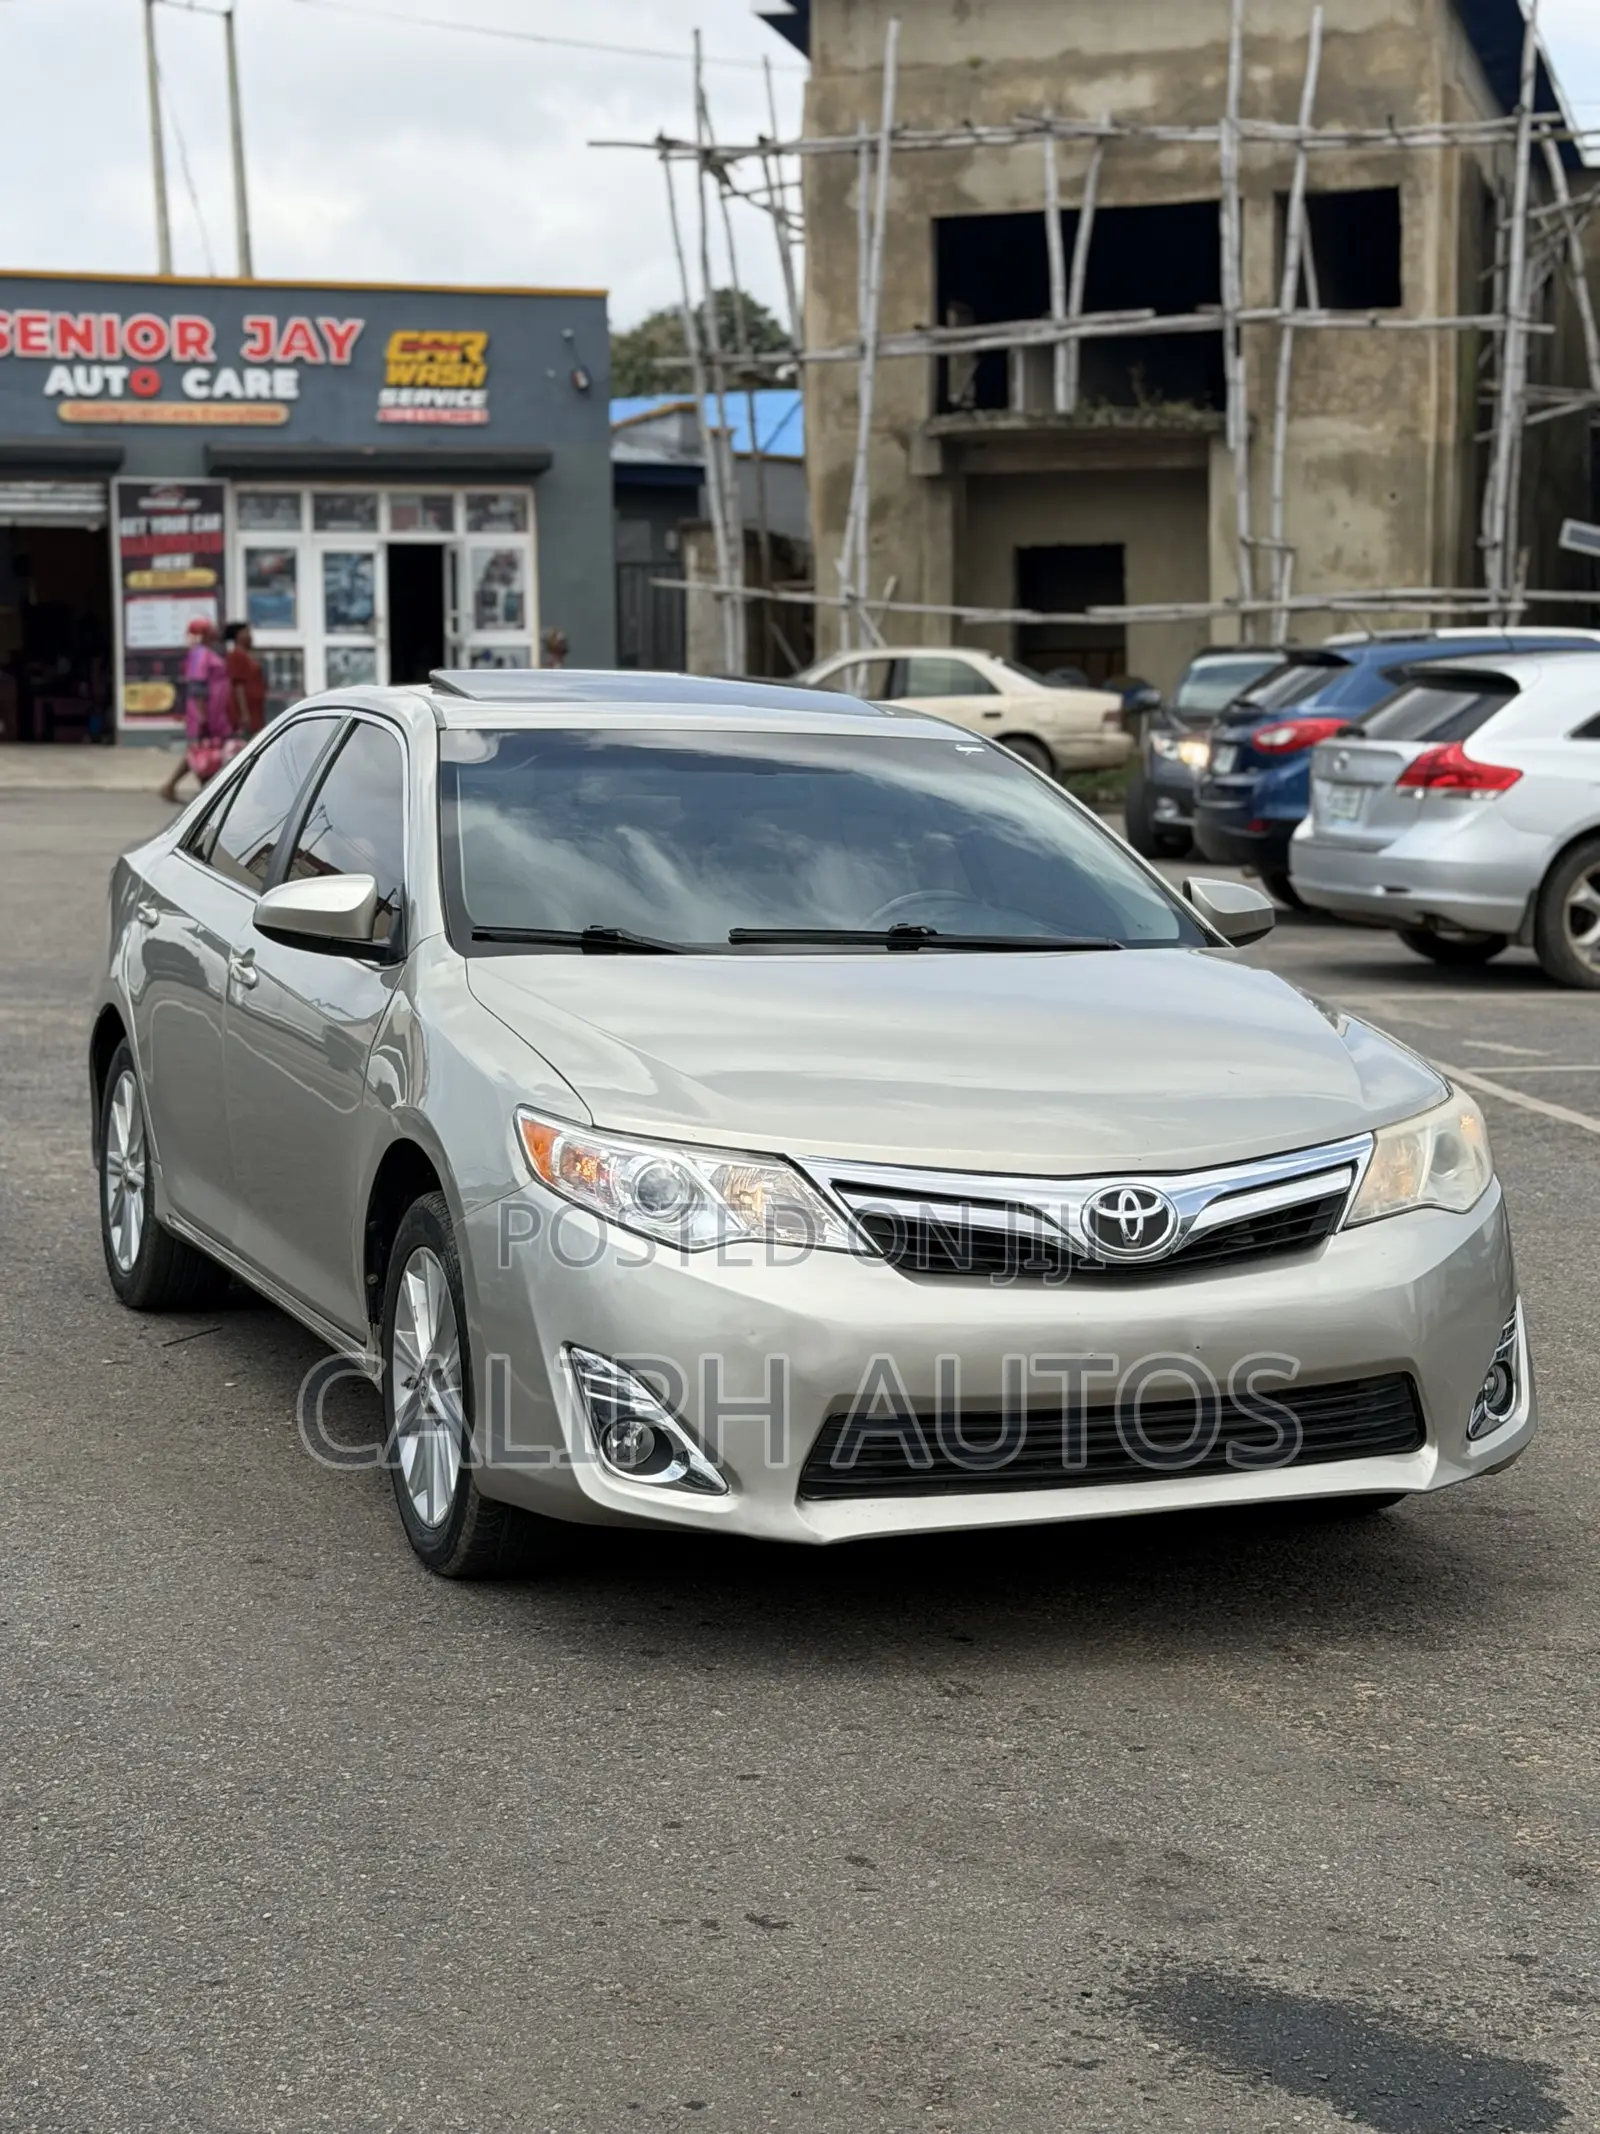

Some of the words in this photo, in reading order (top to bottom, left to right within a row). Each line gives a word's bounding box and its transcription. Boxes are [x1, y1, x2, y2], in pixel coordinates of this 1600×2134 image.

[240, 315, 365, 366] JAY
[386, 331, 488, 363] CAR
[44, 365, 161, 398] AUTO
[181, 367, 299, 399] CARE
[385, 361, 487, 387] WASH
[378, 388, 488, 408] SERVICE
